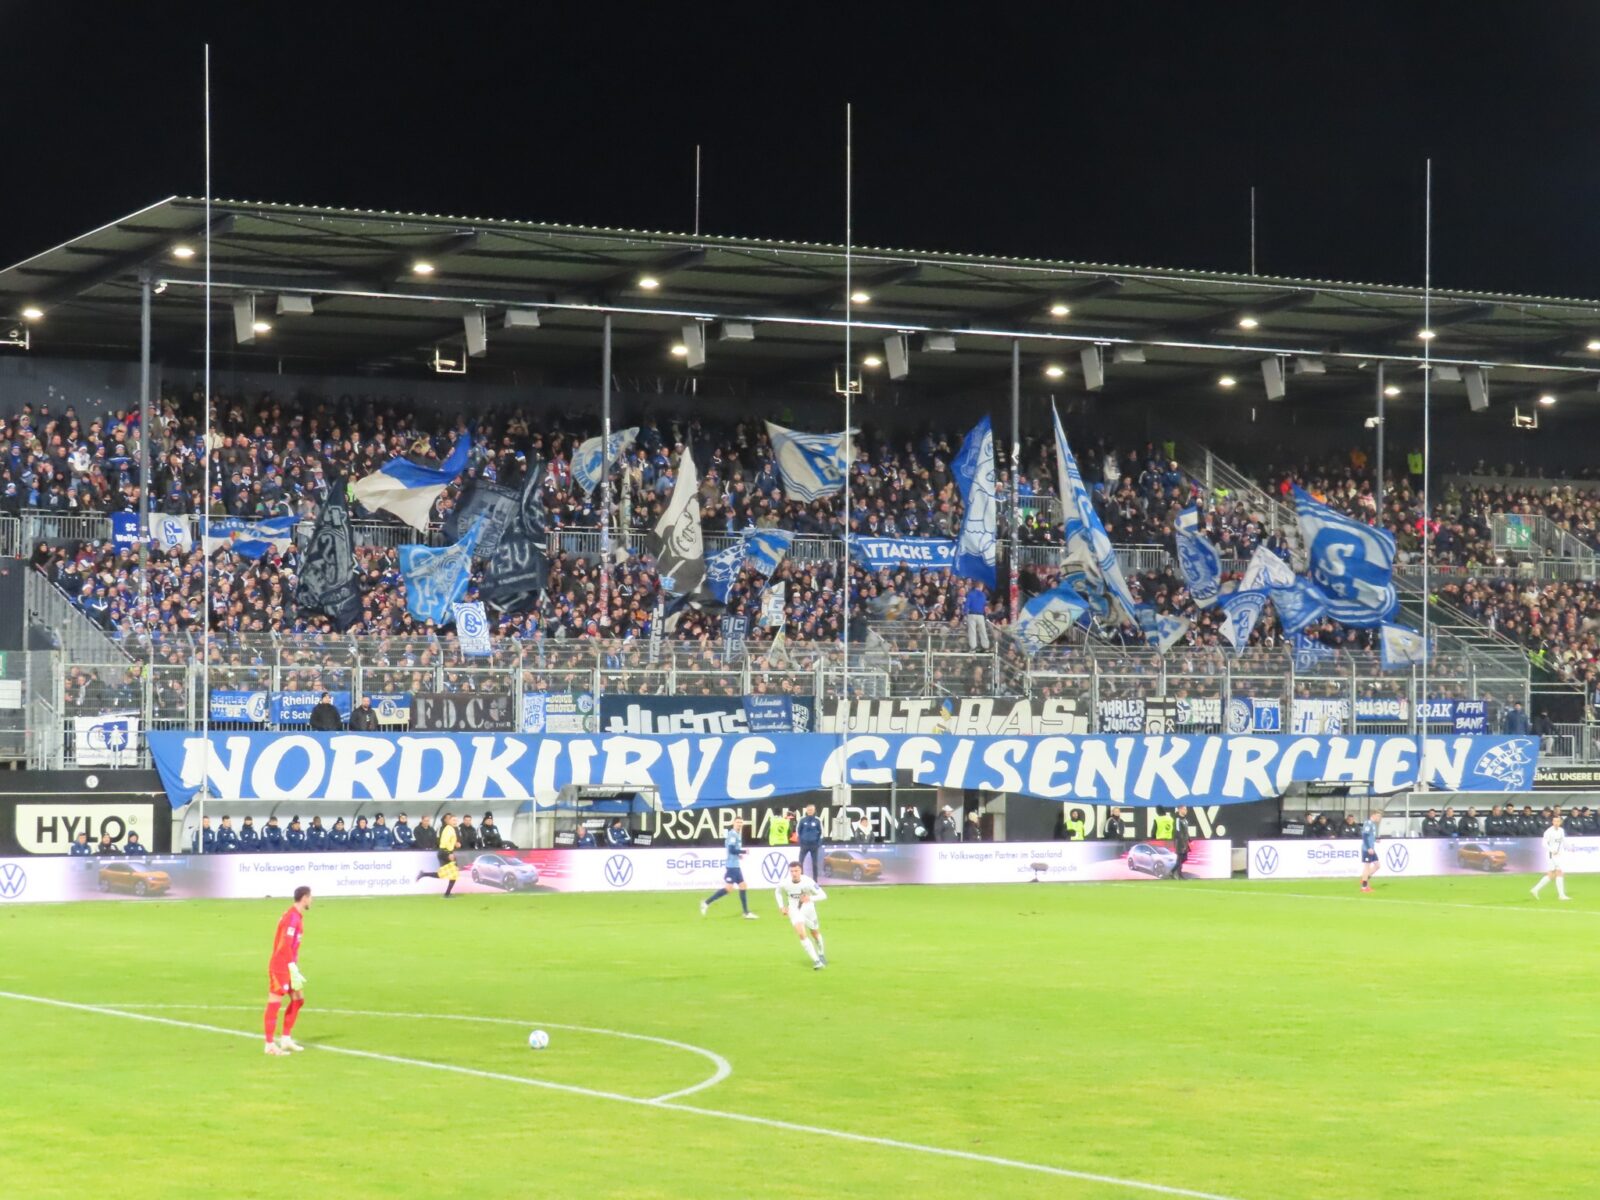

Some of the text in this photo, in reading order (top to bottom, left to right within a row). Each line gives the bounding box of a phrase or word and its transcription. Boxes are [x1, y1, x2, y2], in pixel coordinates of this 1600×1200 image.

[282, 694, 335, 707] Rheinlad
[1098, 699, 1145, 718] MARLER
[1102, 717, 1143, 732] JUNGS
[180, 735, 776, 808] NORDKURVE
[1560, 772, 1592, 781] UNSERE
[36, 815, 127, 843] HYLO
[938, 848, 1062, 862] Ihr Volkswagen Partner im Saarland
[1307, 849, 1359, 859] SCHERER
[239, 860, 392, 875] Ihr Volkswagen Partner im Saarland
